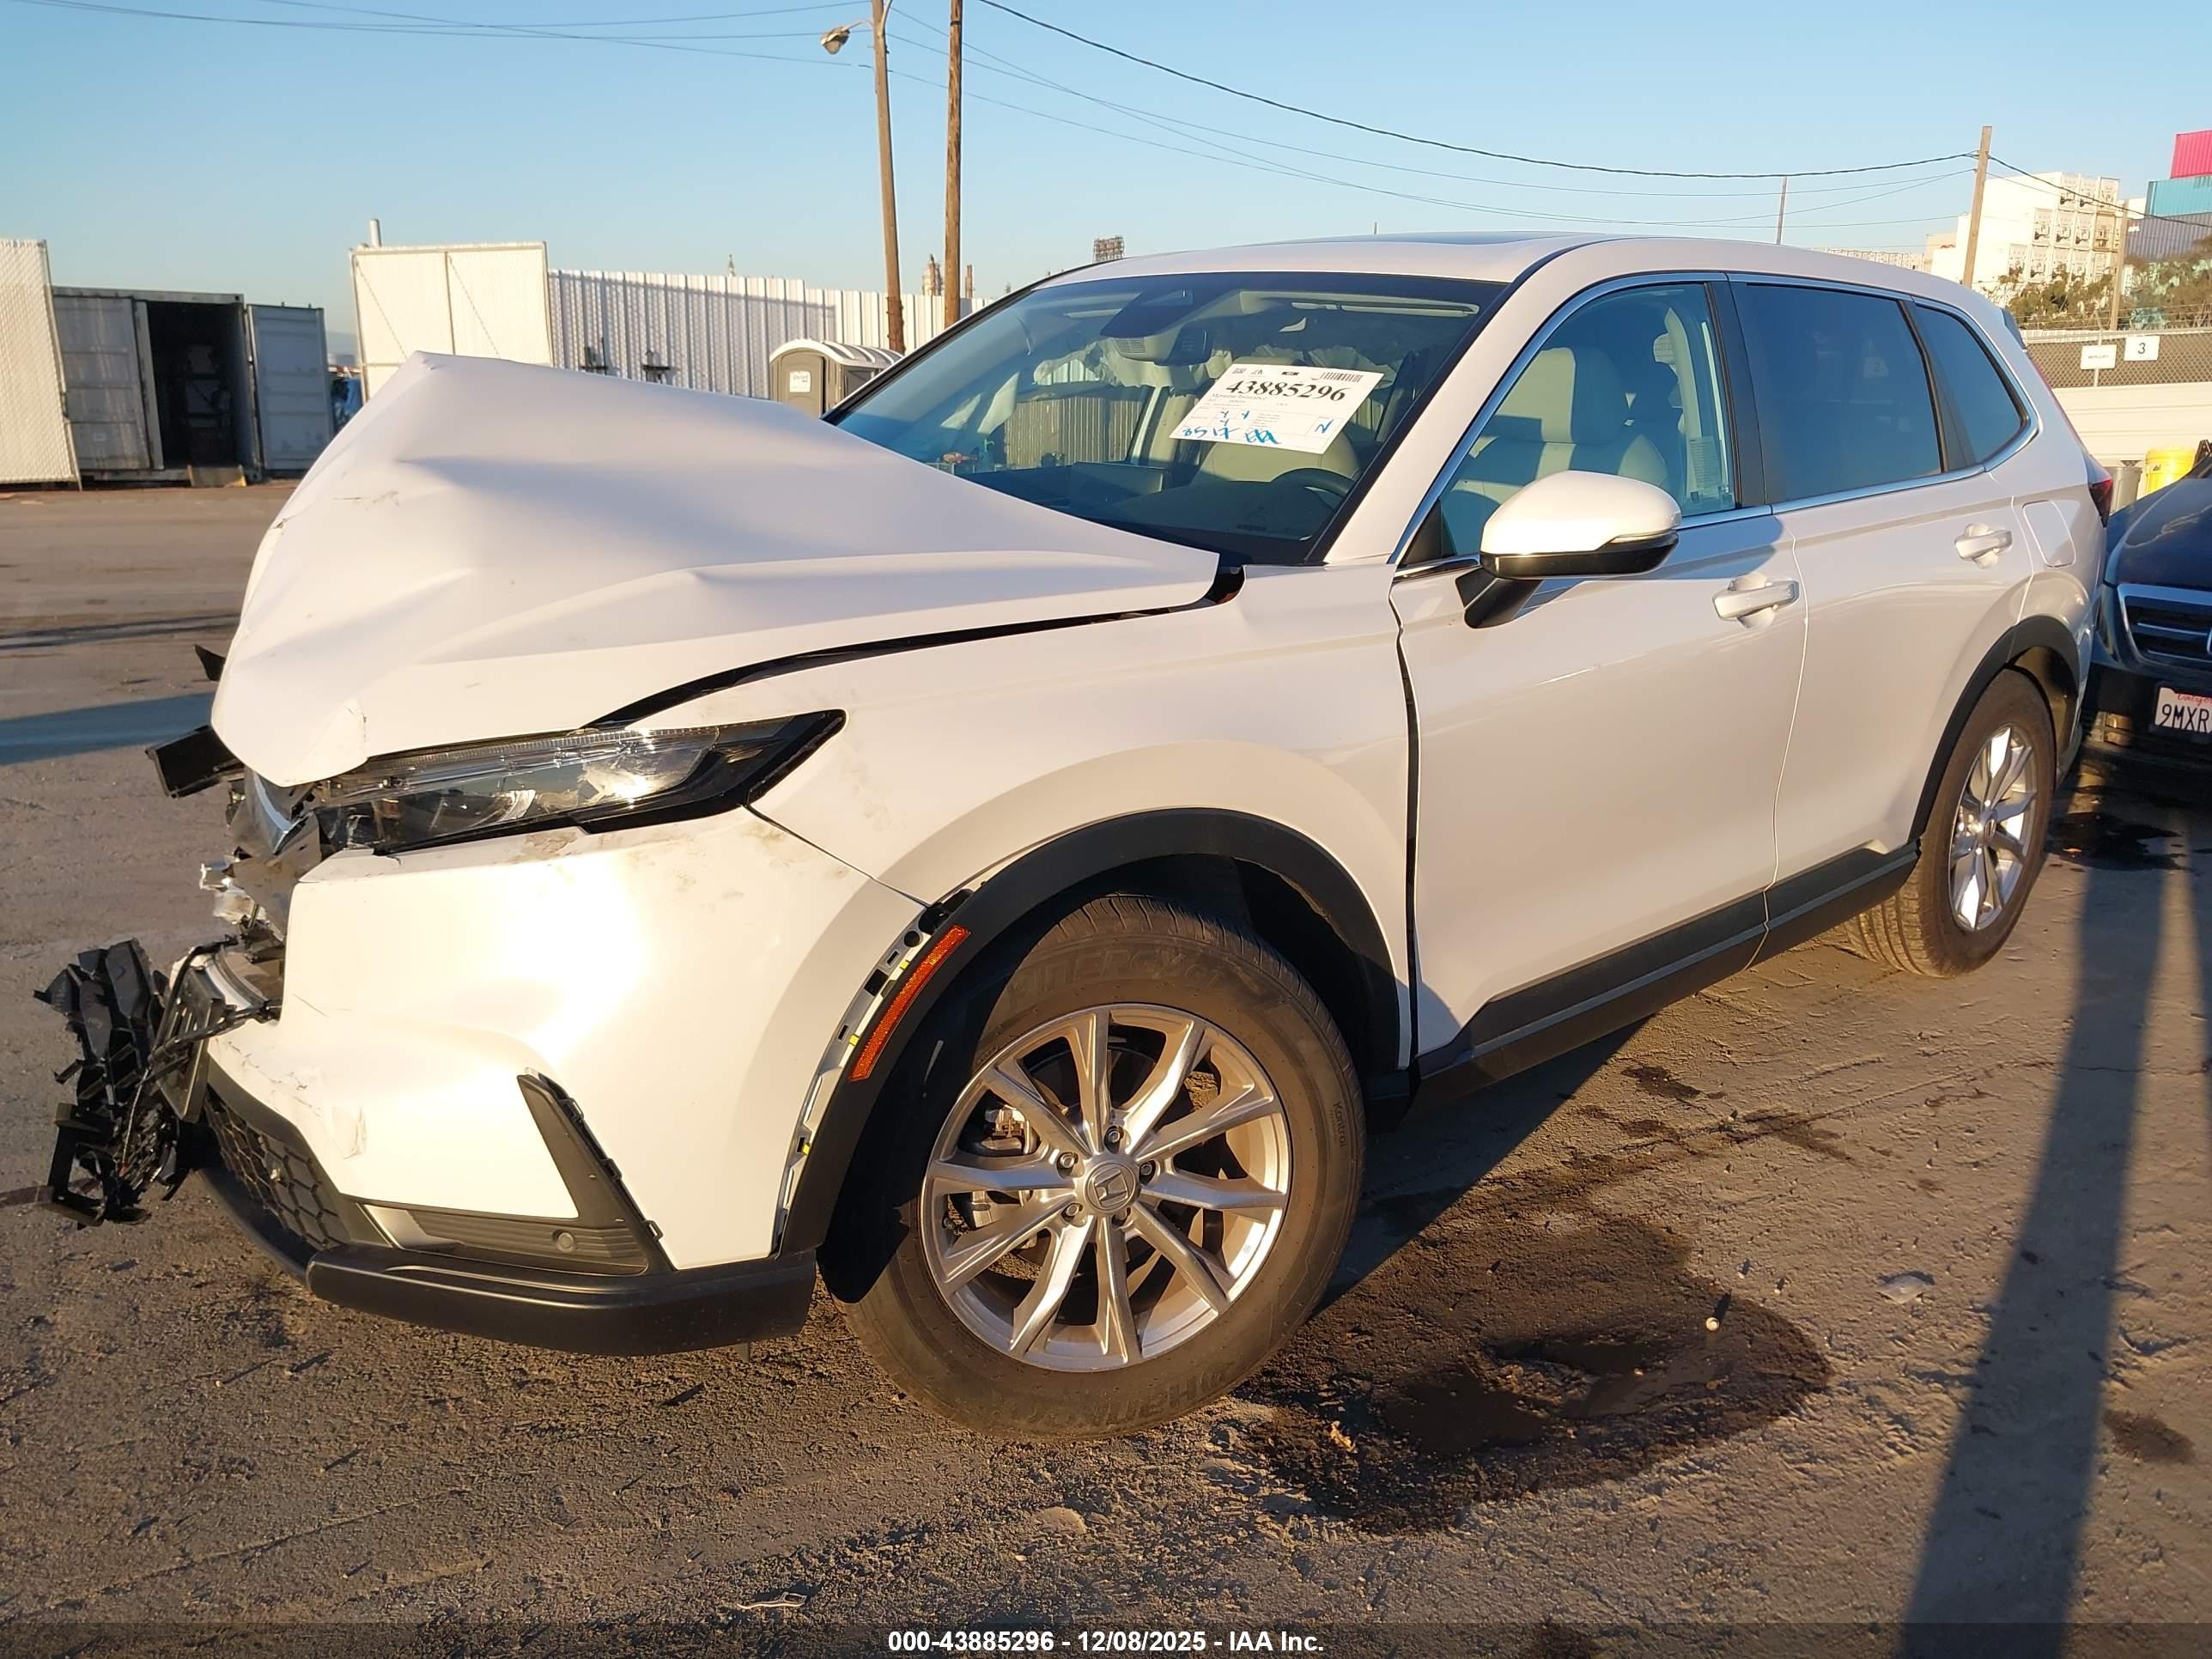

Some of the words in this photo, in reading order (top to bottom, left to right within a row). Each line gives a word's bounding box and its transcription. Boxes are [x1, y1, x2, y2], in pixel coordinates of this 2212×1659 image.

[2137, 342, 2146, 355] 3
[1225, 379, 1354, 403] 43885296
[2159, 703, 2210, 732] 9MXR
